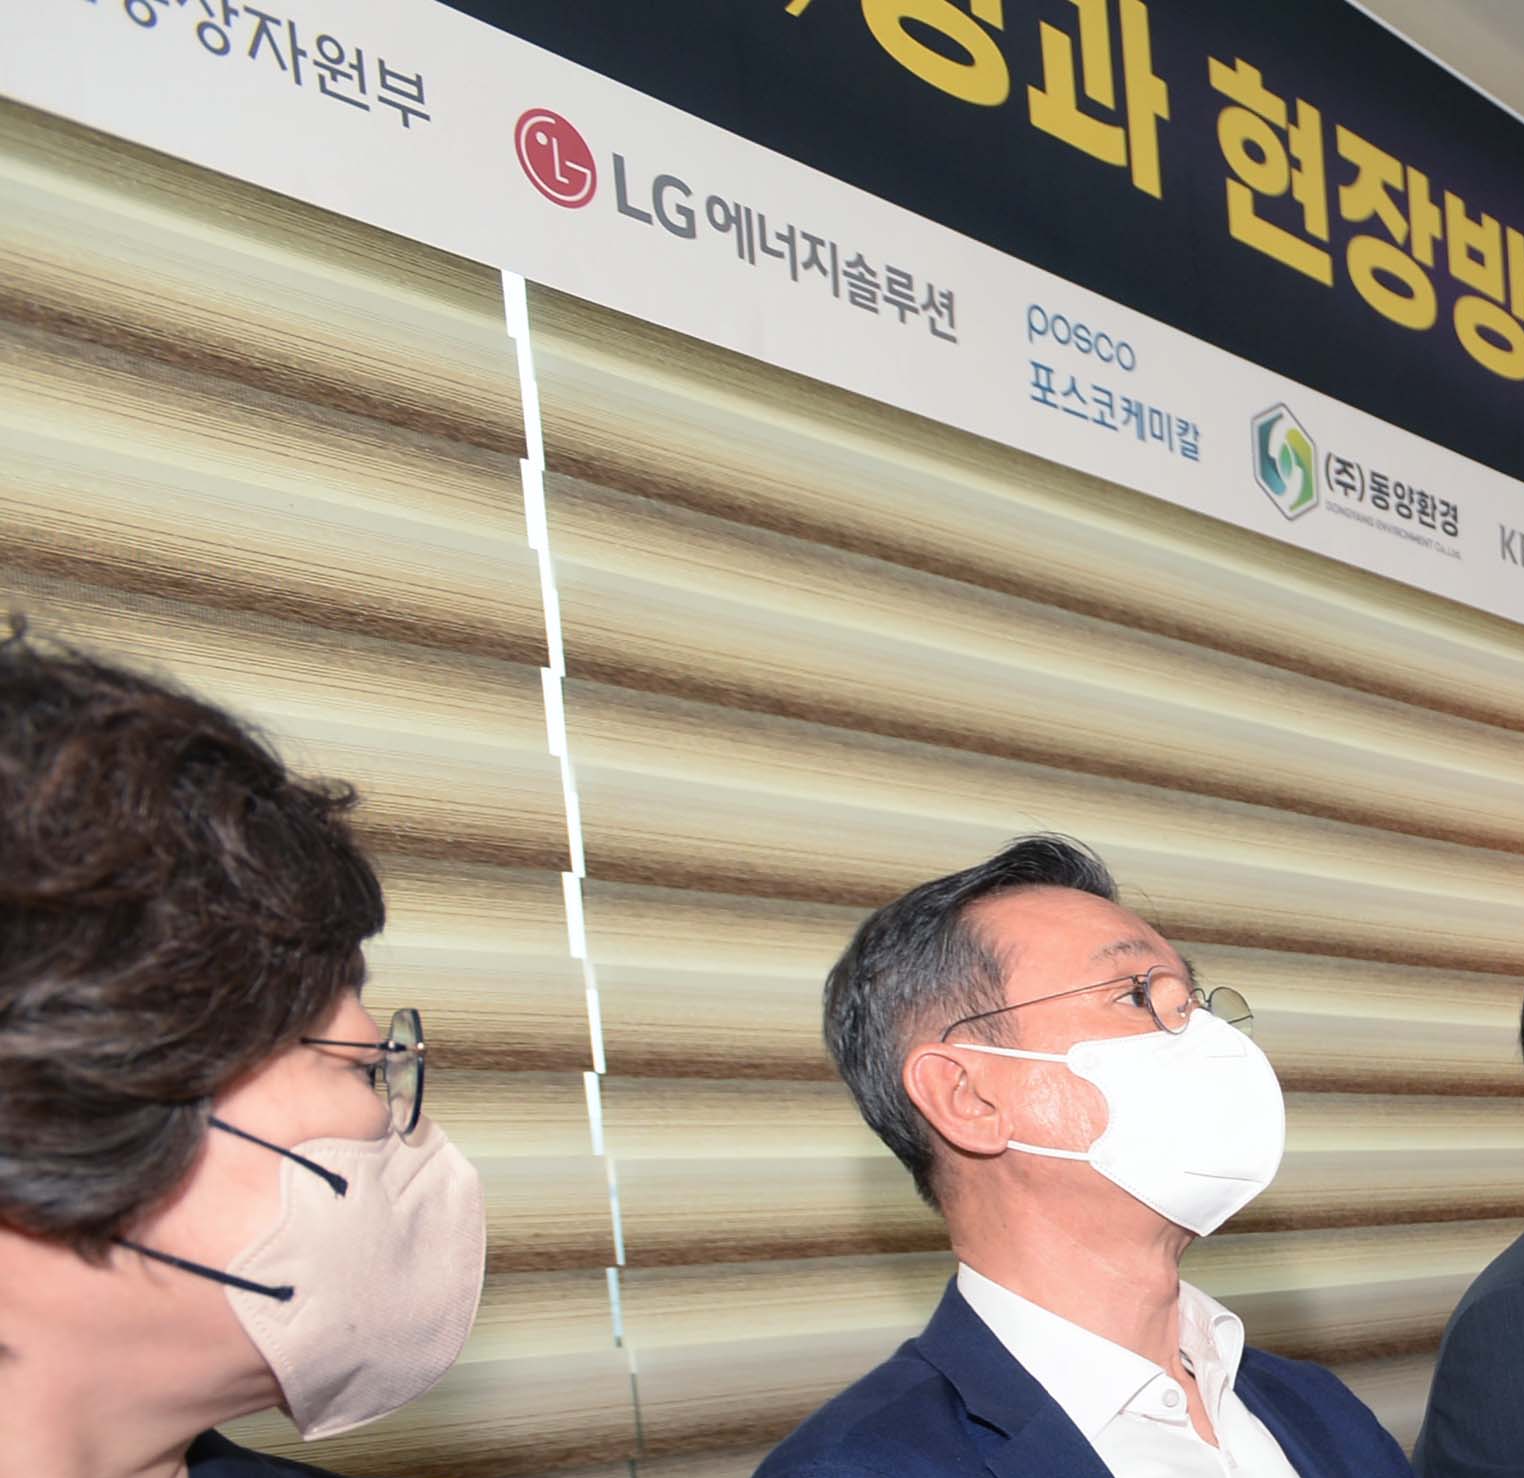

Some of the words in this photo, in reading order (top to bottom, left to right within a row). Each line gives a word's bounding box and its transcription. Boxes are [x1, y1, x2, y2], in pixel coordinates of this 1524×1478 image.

[124, 0, 431, 128] 상자원부
[610, 154, 697, 241] LG
[704, 193, 958, 344] 에너지솔루션
[1027, 303, 1136, 372] posco
[1028, 360, 1202, 464] 포스코케미칼
[1325, 452, 1459, 538] (주)동양환경
